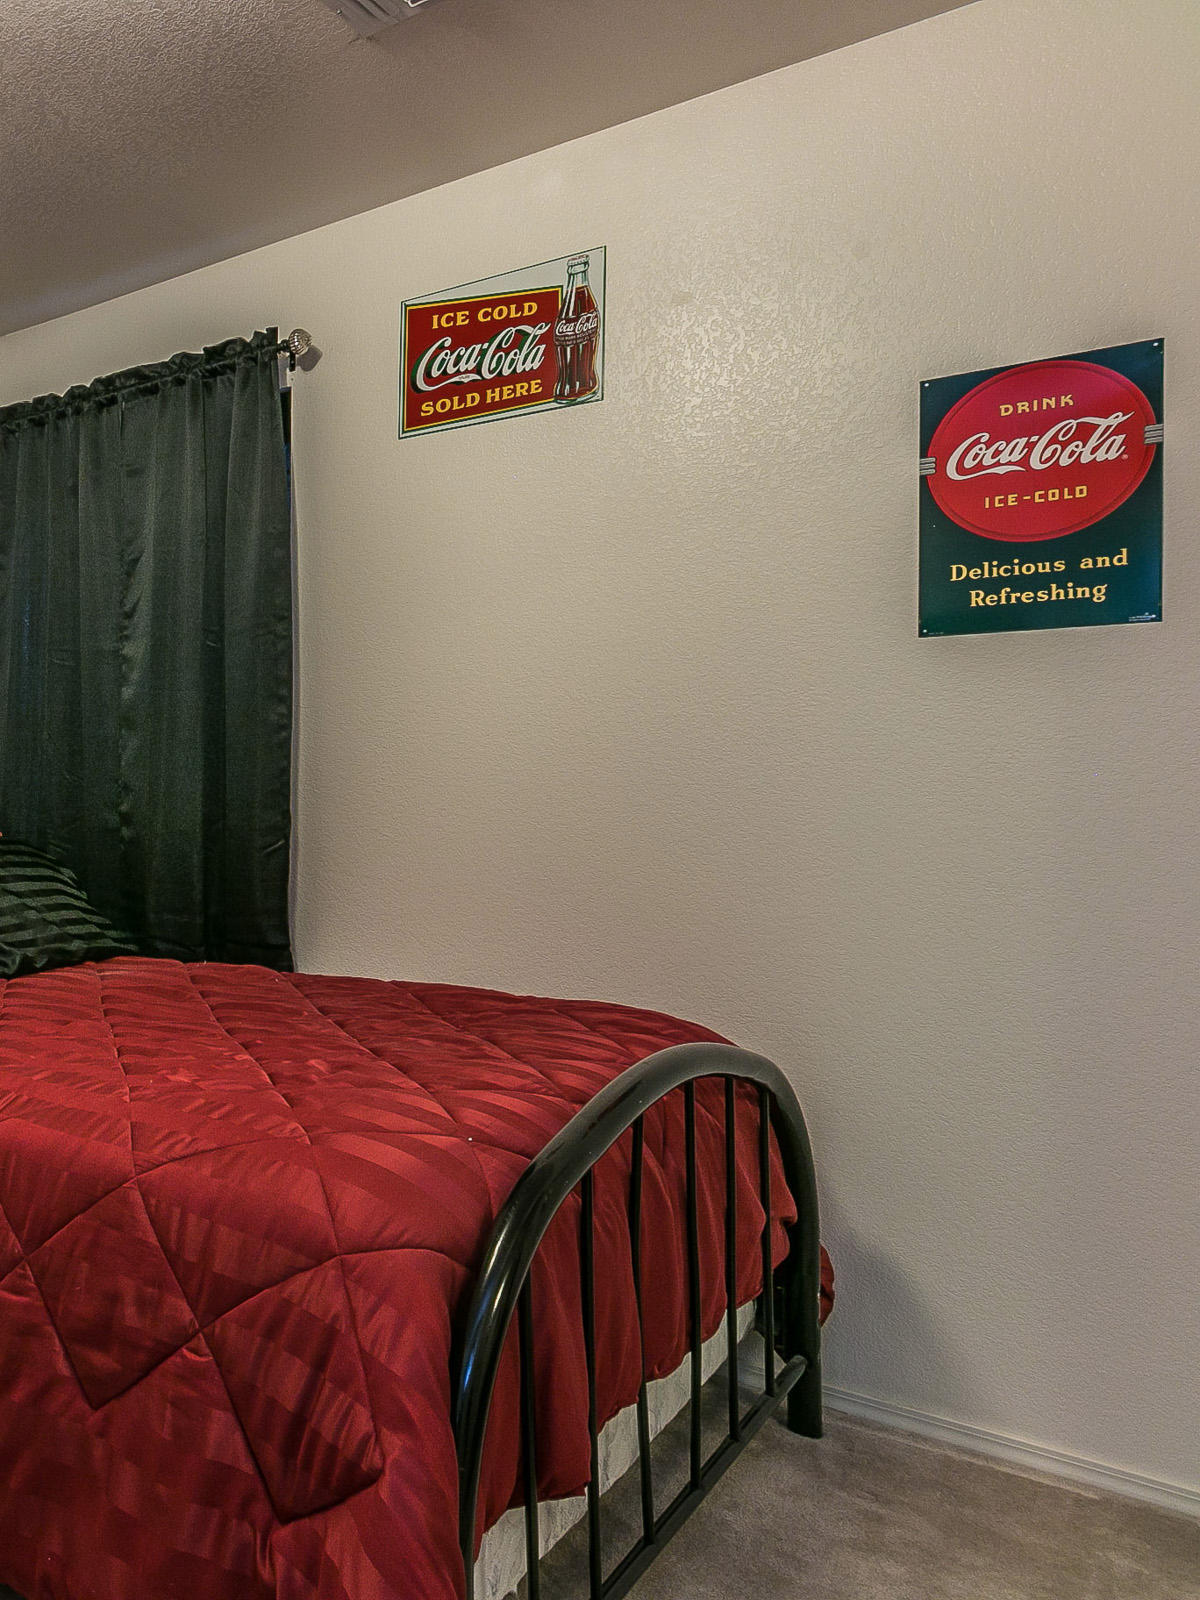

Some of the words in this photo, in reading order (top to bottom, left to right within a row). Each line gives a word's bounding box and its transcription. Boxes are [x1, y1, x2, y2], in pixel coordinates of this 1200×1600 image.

[431, 310, 470, 330] ICE
[477, 302, 538, 323] COLD
[414, 322, 551, 392] Coca-Cola
[420, 392, 480, 417] SOLD
[485, 379, 543, 404] HERE
[999, 394, 1075, 417] DRINK
[946, 411, 1135, 481] Coca-Cola
[984, 485, 1089, 509] ICE-COLD
[950, 558, 1067, 582] Delicious
[1080, 548, 1129, 571] and
[969, 582, 1109, 608] Refreshing
